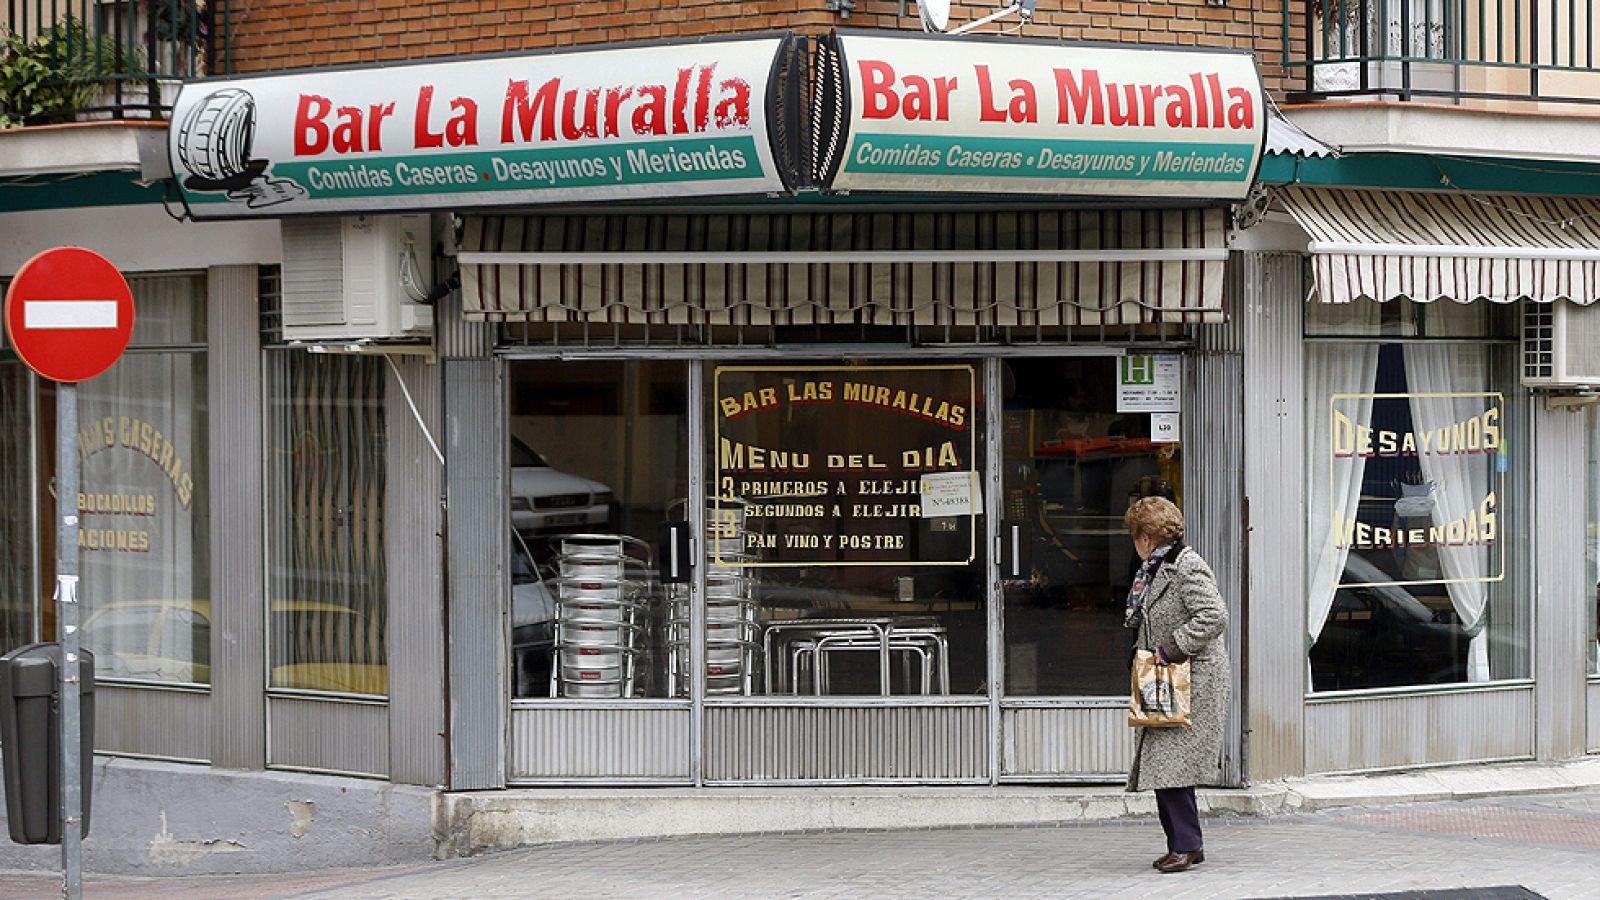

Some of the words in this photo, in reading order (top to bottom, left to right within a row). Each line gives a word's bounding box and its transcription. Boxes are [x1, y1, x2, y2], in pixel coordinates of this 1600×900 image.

[294, 92, 395, 156] Bar
[414, 85, 479, 149] La
[501, 61, 752, 144] Muralla
[858, 60, 958, 122] Bar
[973, 64, 1038, 123] La
[1053, 67, 1254, 130] Muralla
[307, 162, 393, 191] Comidas
[395, 159, 478, 186] Caseras
[491, 155, 607, 185] Desayunos
[609, 157, 625, 181] y
[627, 145, 747, 174] Meriendas
[855, 141, 942, 167] Comidas
[946, 144, 1022, 168] Caseras
[1037, 147, 1135, 173] Desayunos
[1136, 155, 1148, 176] y
[1153, 150, 1245, 174] Meriendas
[1125, 355, 1152, 383] H
[720, 387, 777, 418] BAR
[788, 381, 833, 401] LAS
[843, 383, 966, 427] MURALLAS
[1335, 407, 1500, 455] DESAYUNOS
[119, 416, 193, 508] CASERAS
[721, 437, 809, 470] MENU
[827, 454, 887, 468] DEL
[902, 441, 958, 468] DIA
[78, 493, 155, 513] BOCADILLOS
[722, 476, 735, 502] 3
[740, 480, 829, 495] PRIMEROS
[836, 480, 847, 495] A
[858, 479, 932, 496] ELEJIR
[745, 504, 825, 518] SEGUNDOS
[832, 504, 842, 518] A
[852, 504, 923, 518] ELEJIR
[1335, 491, 1497, 546] MERIENDAS
[78, 528, 149, 549] ACIONES
[747, 534, 776, 548] PAN
[784, 534, 819, 548] VINO
[823, 534, 834, 548] Y
[839, 534, 904, 549] POSTRE
